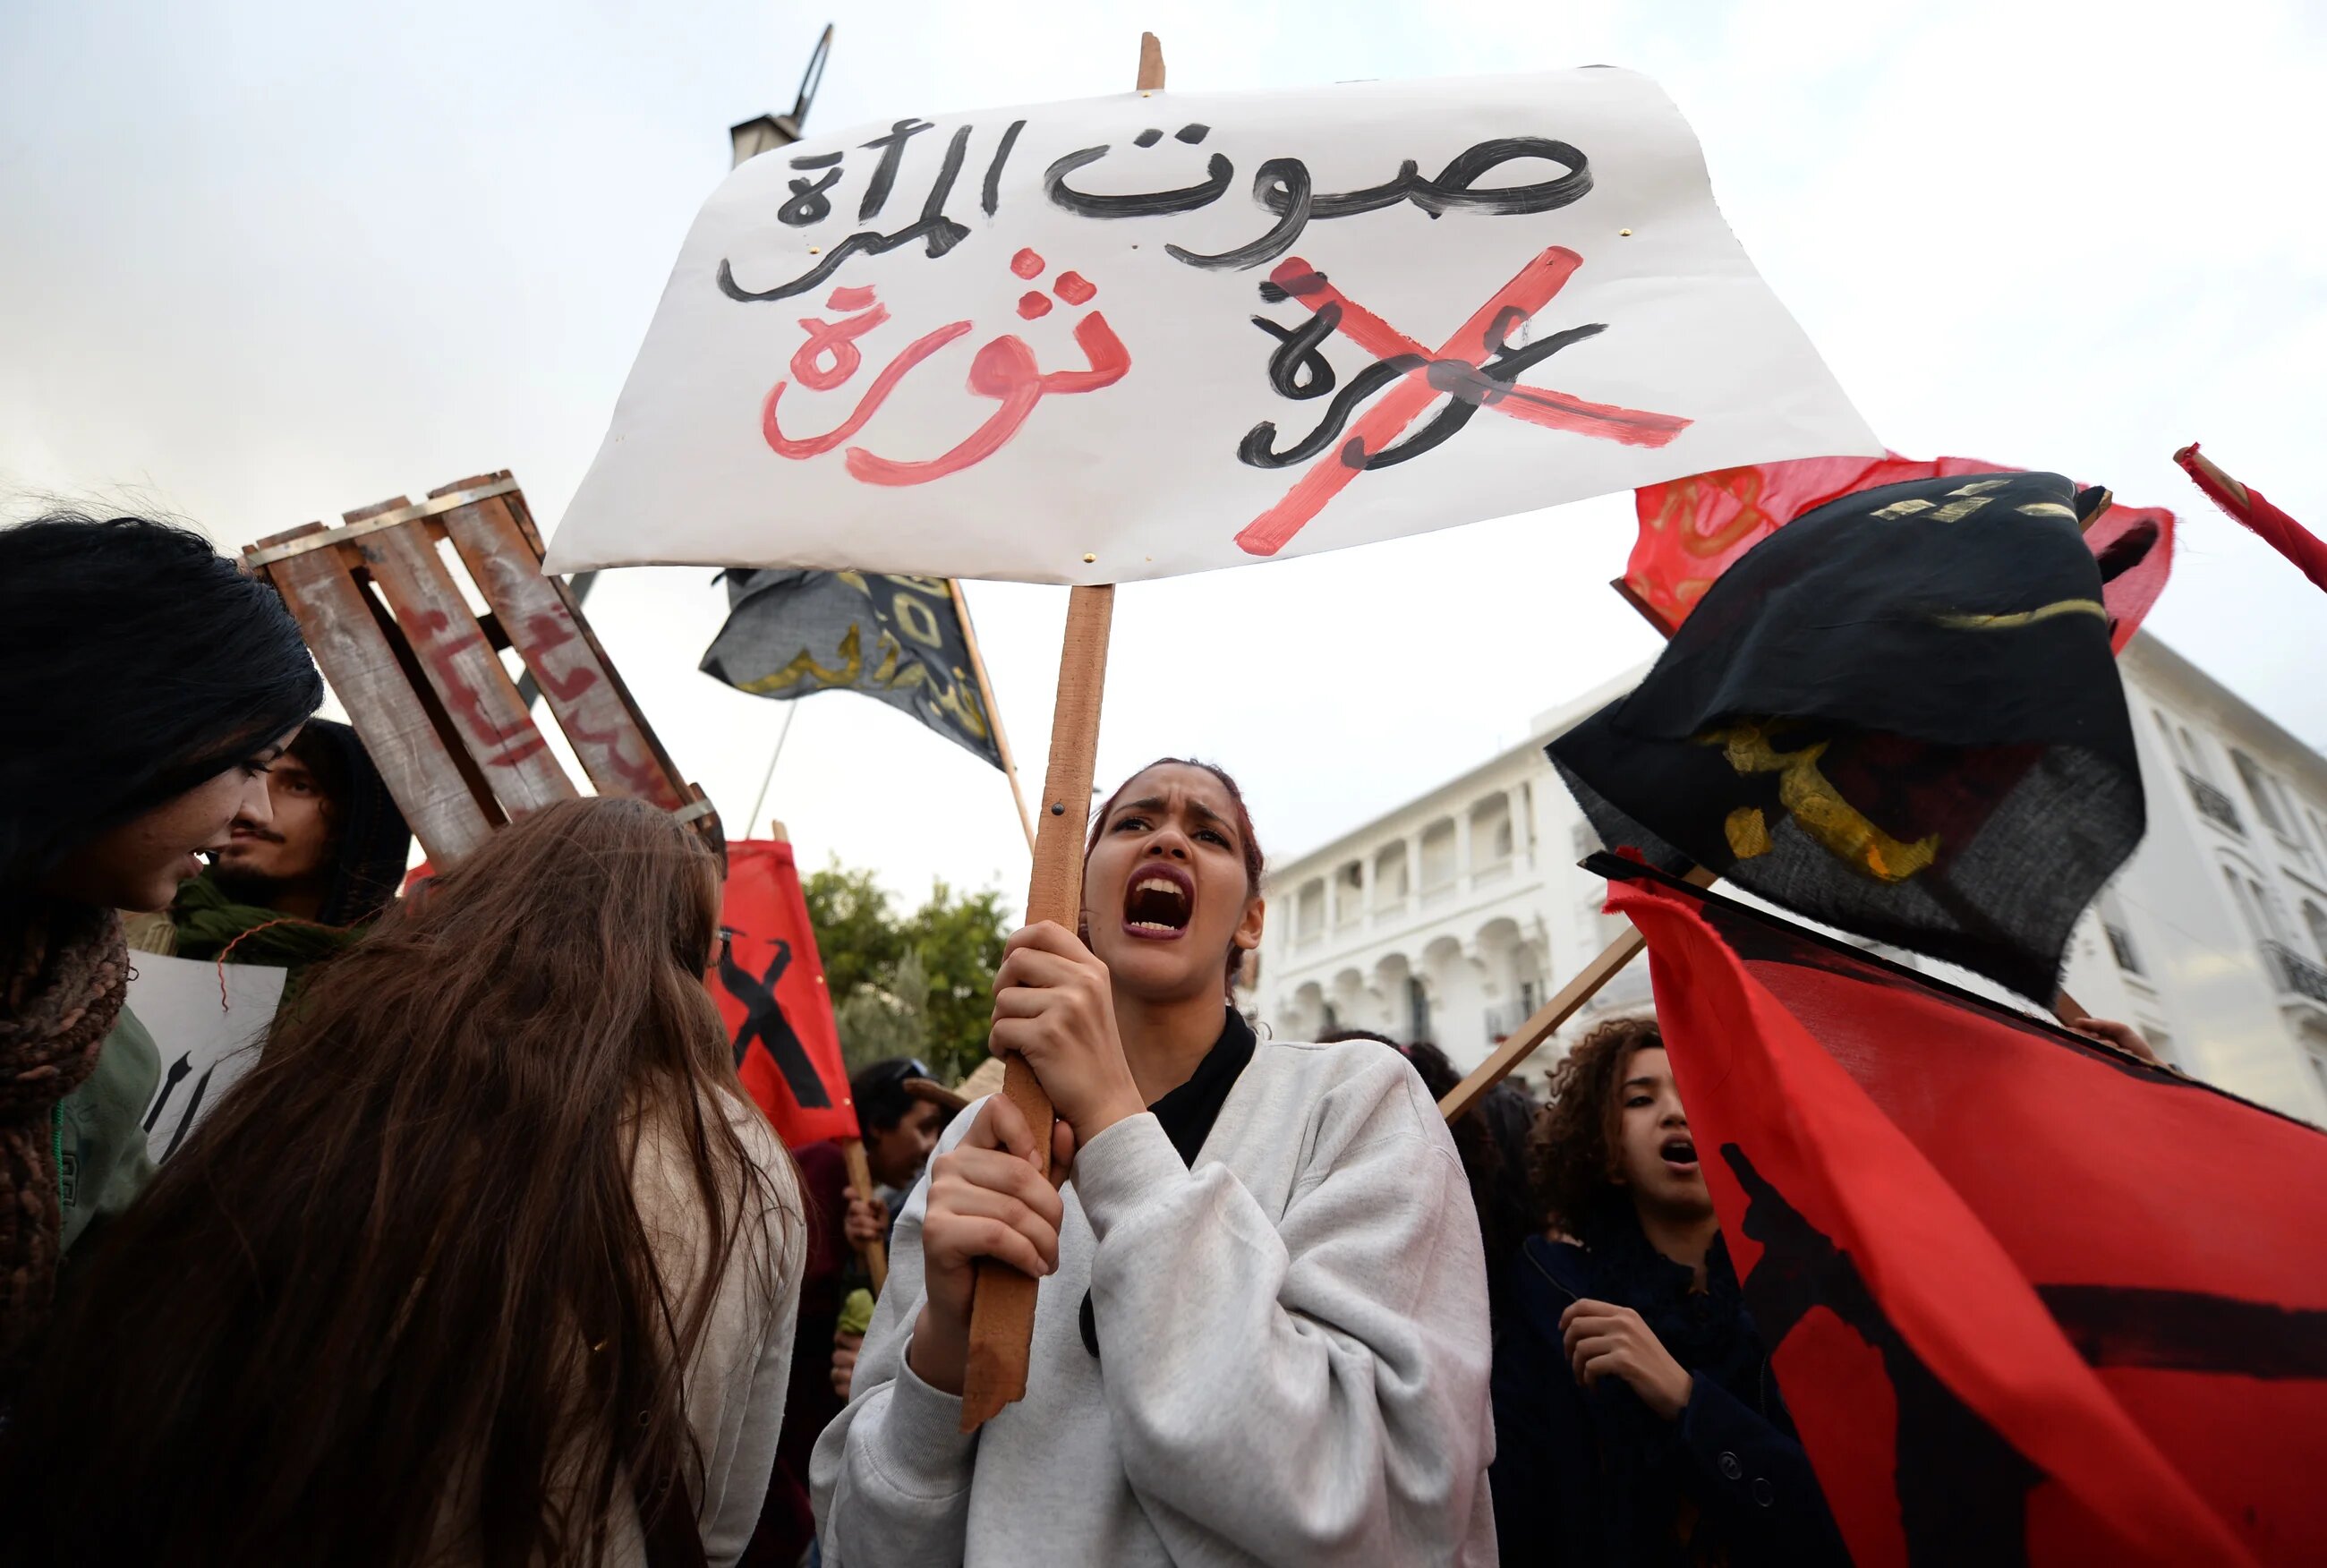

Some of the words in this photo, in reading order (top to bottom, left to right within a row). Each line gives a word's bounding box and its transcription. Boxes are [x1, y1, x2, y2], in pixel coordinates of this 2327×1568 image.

[717, 117, 1027, 303] المرأة
[1043, 123, 1594, 272] صوت
[762, 246, 1131, 487] ثورة
[1237, 271, 1609, 470] عورة
